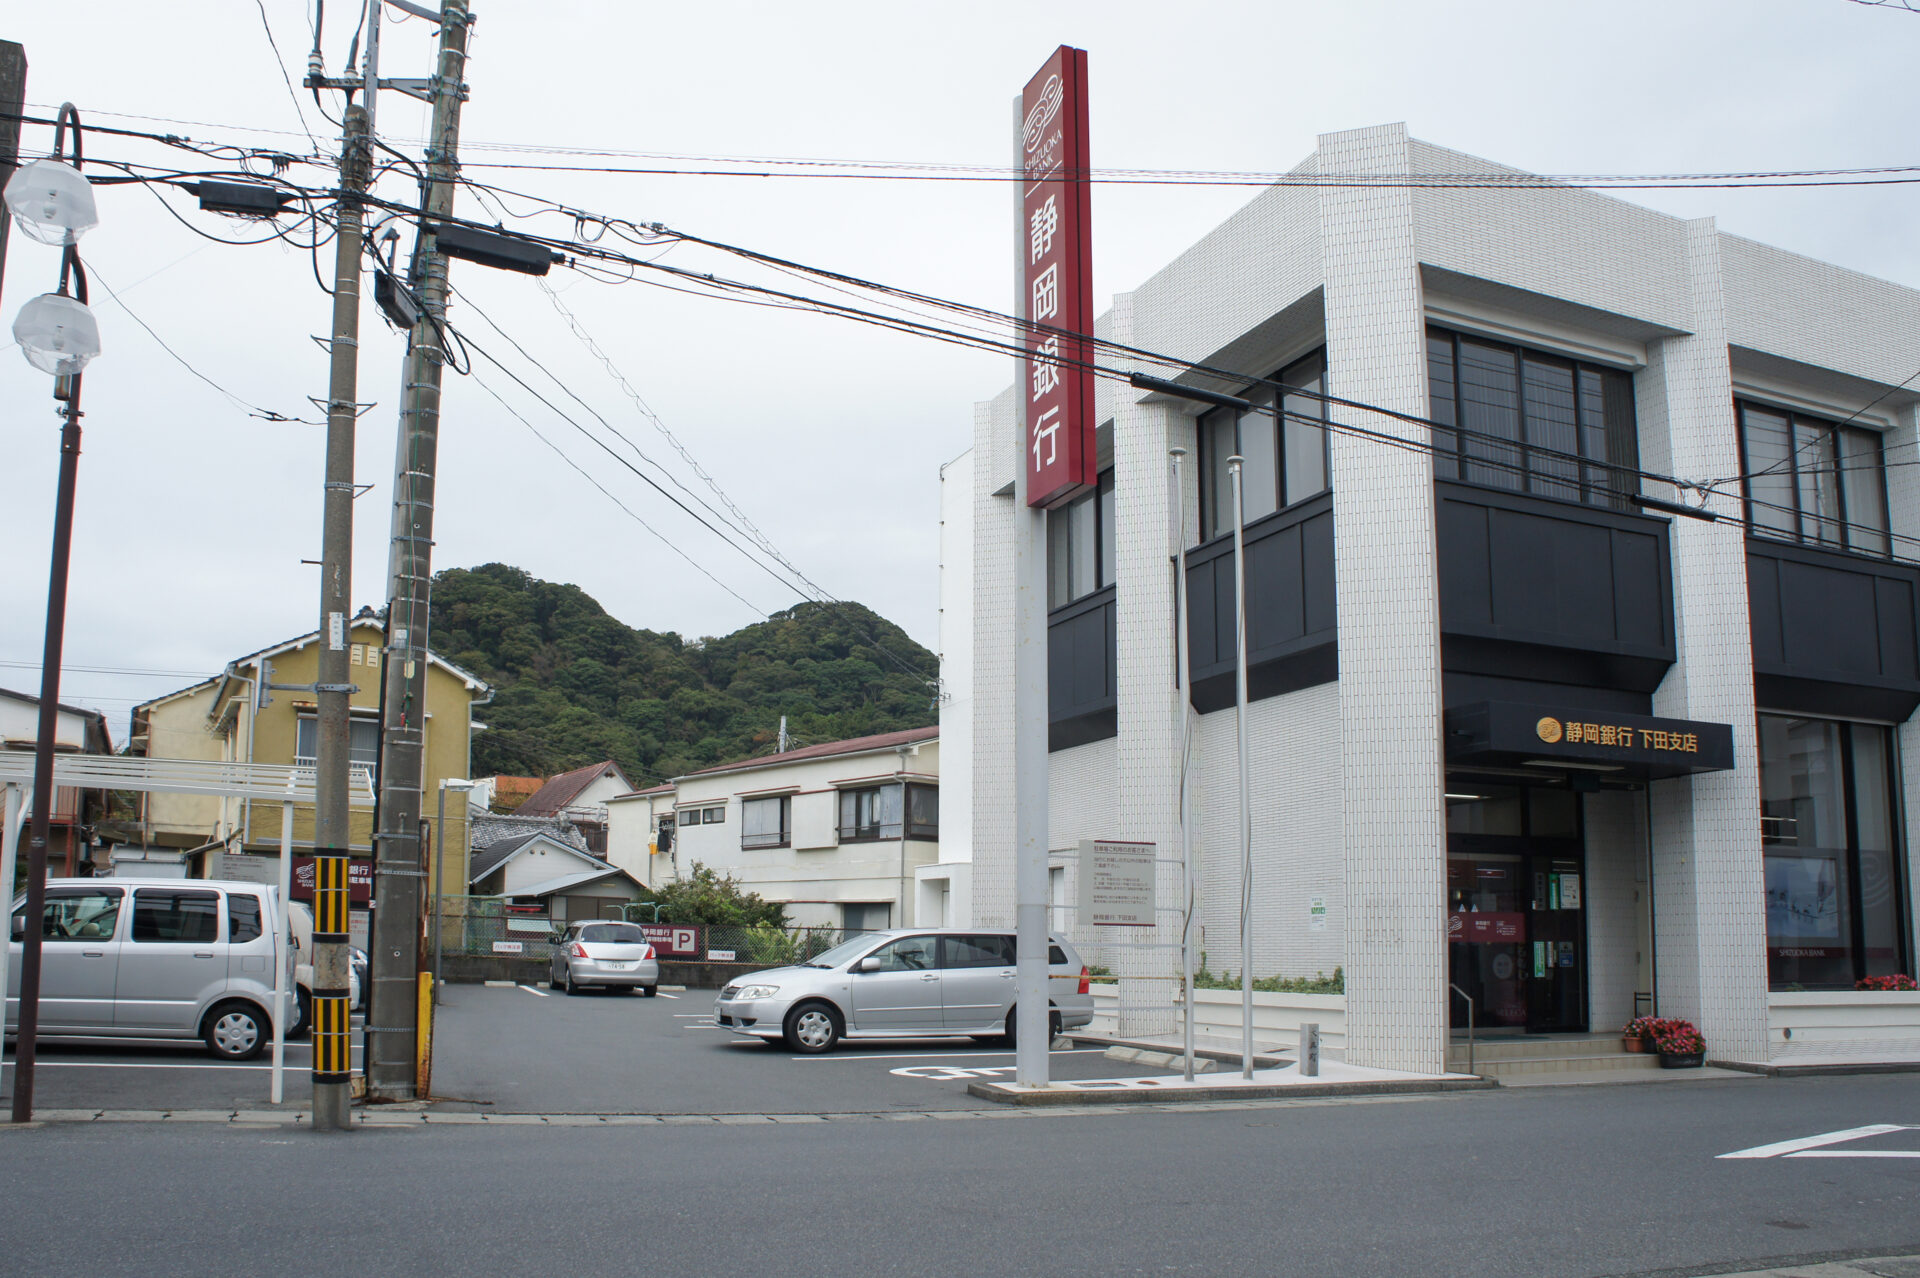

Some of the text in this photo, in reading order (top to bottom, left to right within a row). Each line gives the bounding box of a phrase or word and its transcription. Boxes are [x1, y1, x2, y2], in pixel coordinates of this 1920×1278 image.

[1024, 129, 1062, 176] SHIZUOKA
[1032, 151, 1054, 180] BANK
[1031, 194, 1060, 473] 静岡銀行
[1565, 721, 1699, 753] 静岡銀行 下田支店
[349, 865, 369, 875] 銀行
[679, 933, 691, 948] P
